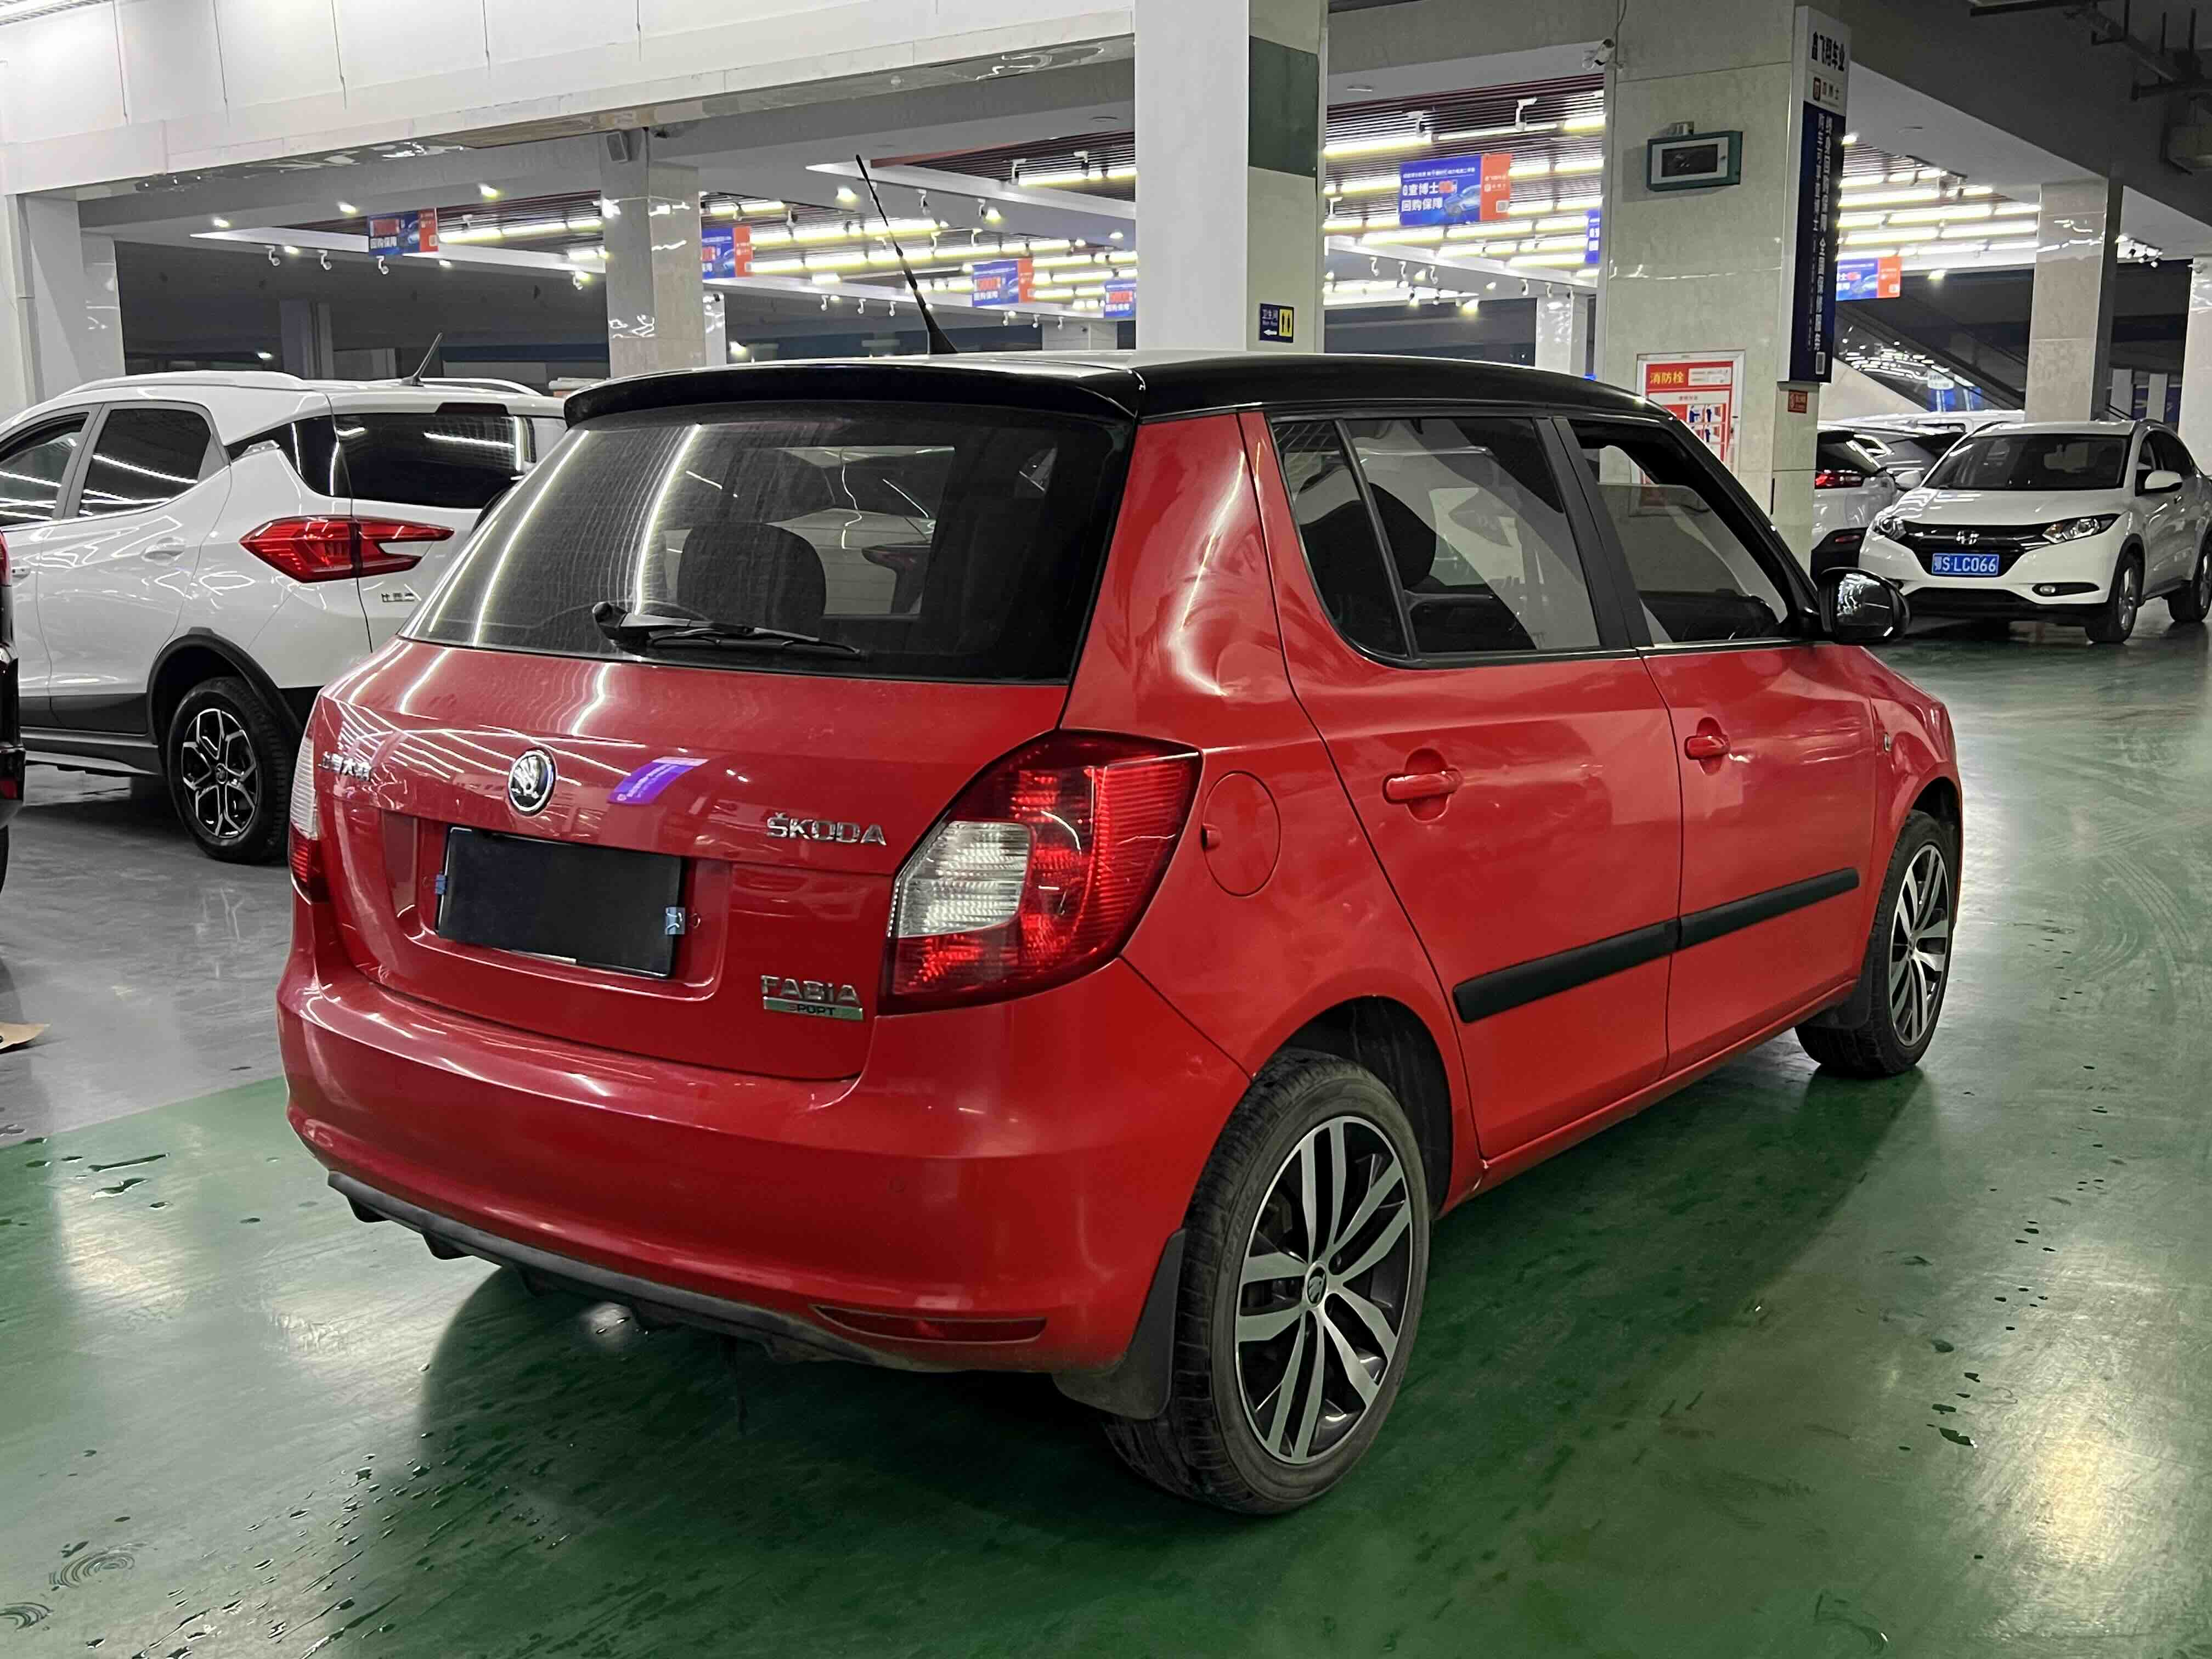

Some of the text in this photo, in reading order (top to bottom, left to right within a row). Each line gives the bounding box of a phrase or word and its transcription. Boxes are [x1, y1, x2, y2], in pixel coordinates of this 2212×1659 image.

[1650, 370, 1685, 384] 消防栓
[766, 812, 887, 846] ŠKODA
[761, 975, 861, 1006] FABIA
